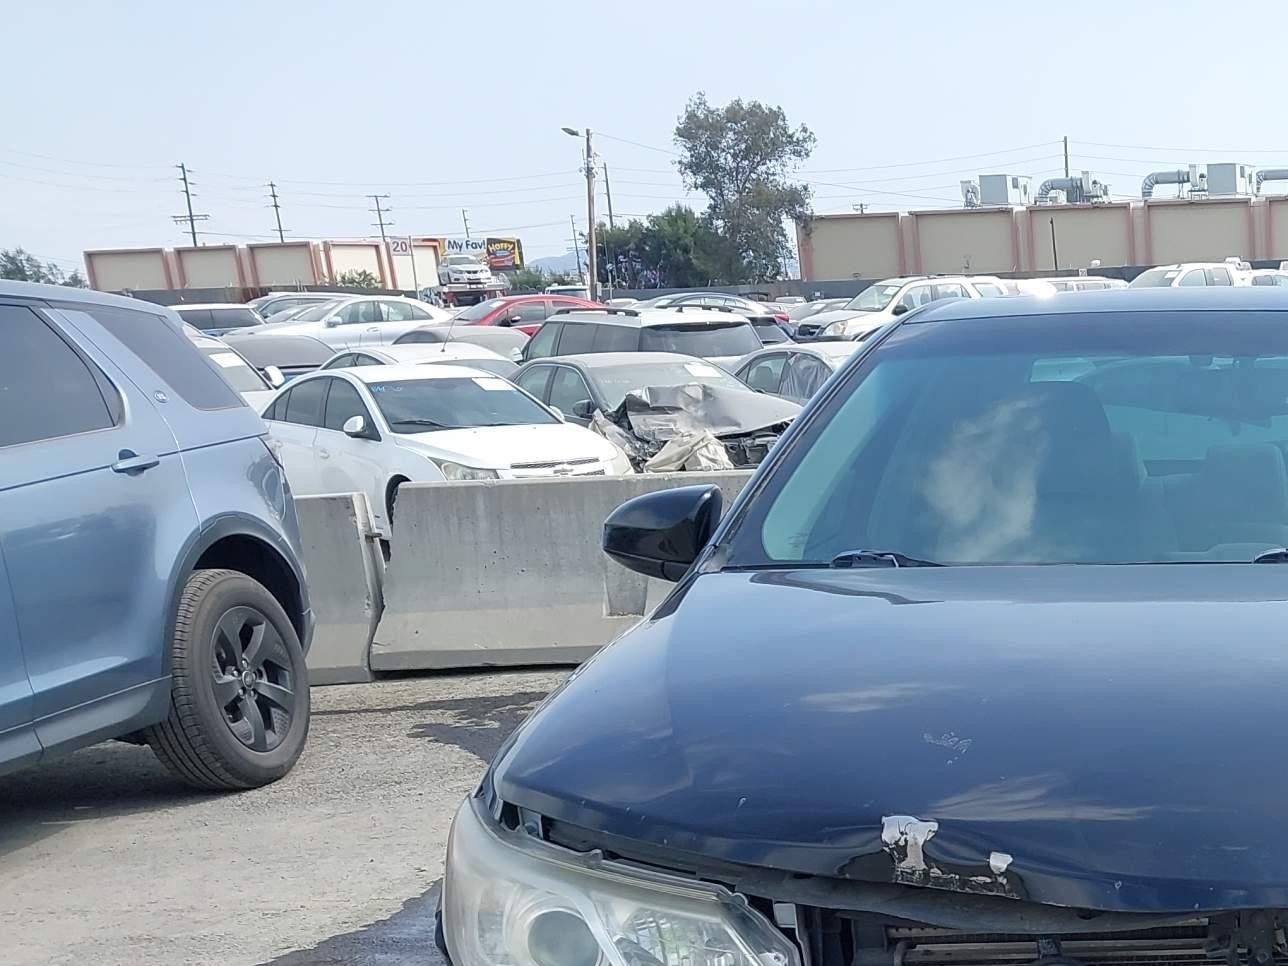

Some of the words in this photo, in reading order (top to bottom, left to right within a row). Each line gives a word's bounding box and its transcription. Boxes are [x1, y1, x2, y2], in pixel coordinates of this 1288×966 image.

[392, 241, 408, 252] 20
[447, 240, 463, 252] My
[465, 239, 486, 250] Fav!
